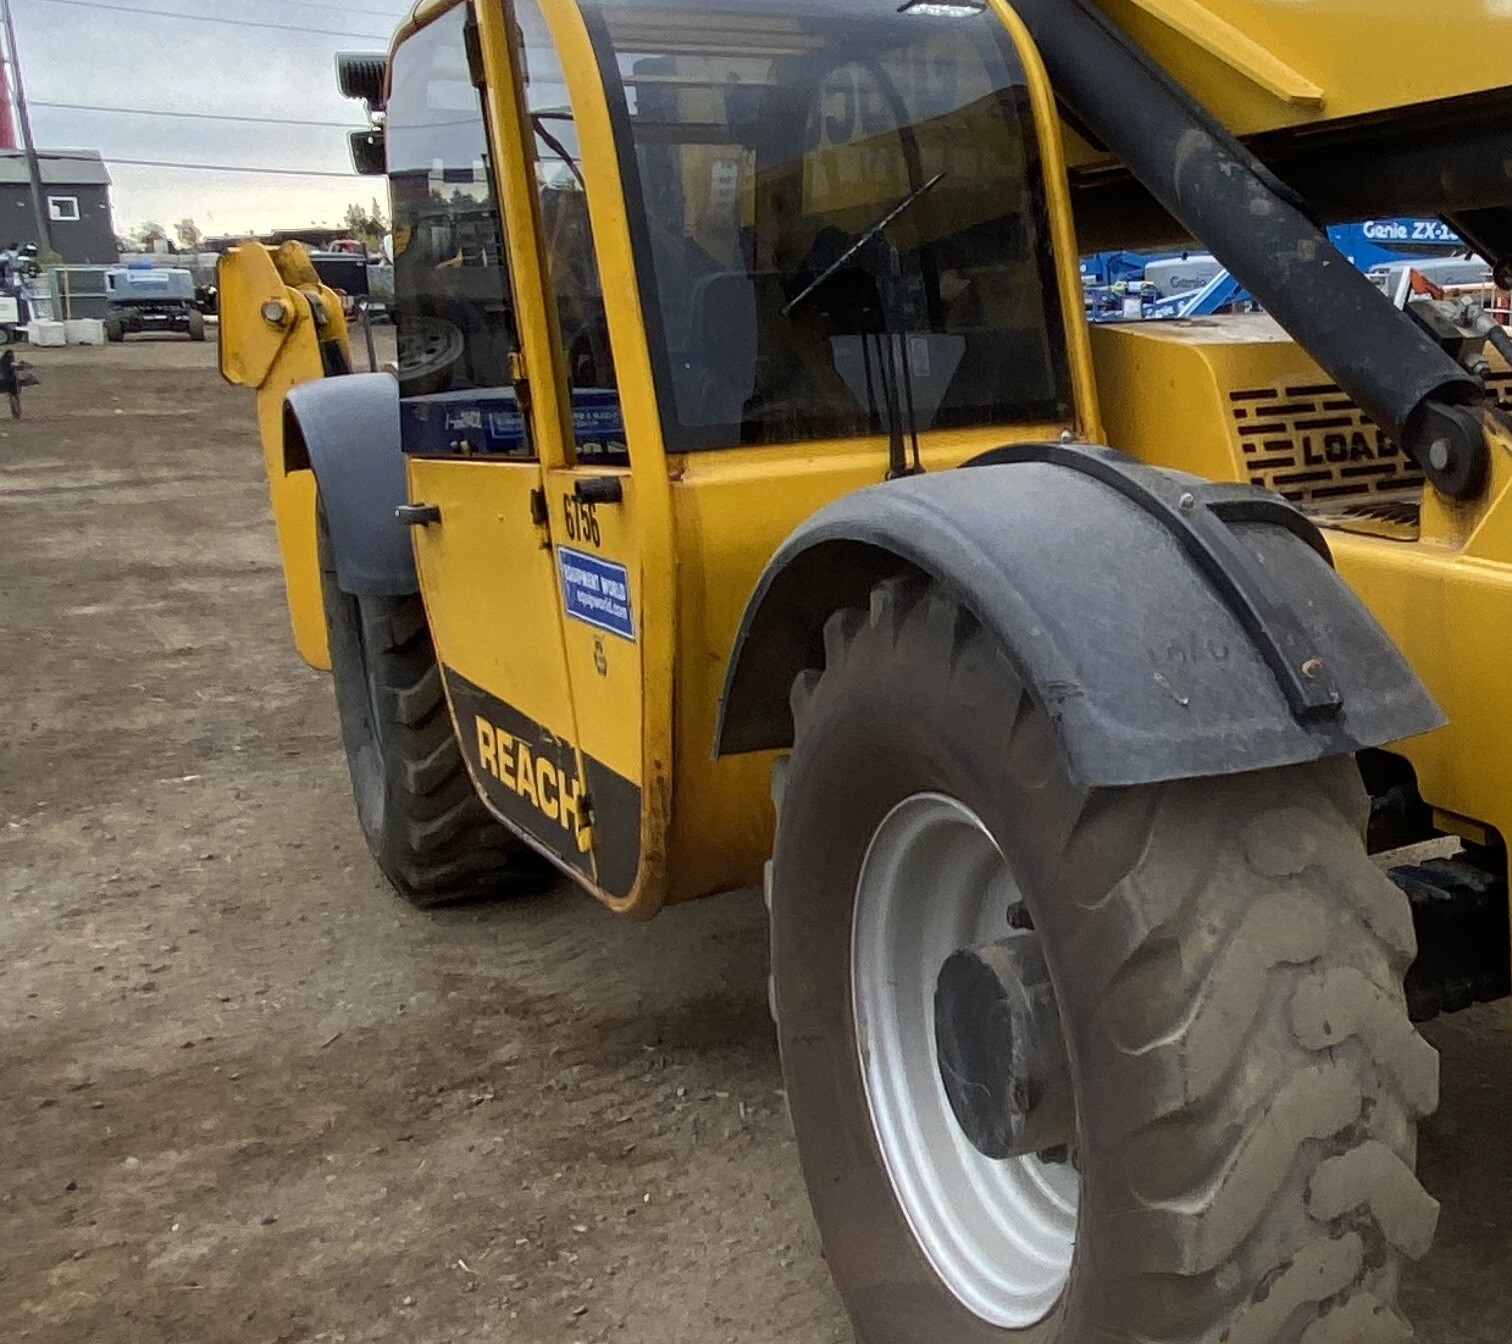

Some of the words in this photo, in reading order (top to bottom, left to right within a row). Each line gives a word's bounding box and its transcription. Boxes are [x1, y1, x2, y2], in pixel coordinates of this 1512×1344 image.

[1362, 220, 1408, 239] Genie
[1411, 221, 1460, 240] ZX-1
[1302, 428, 1399, 466] LOAD
